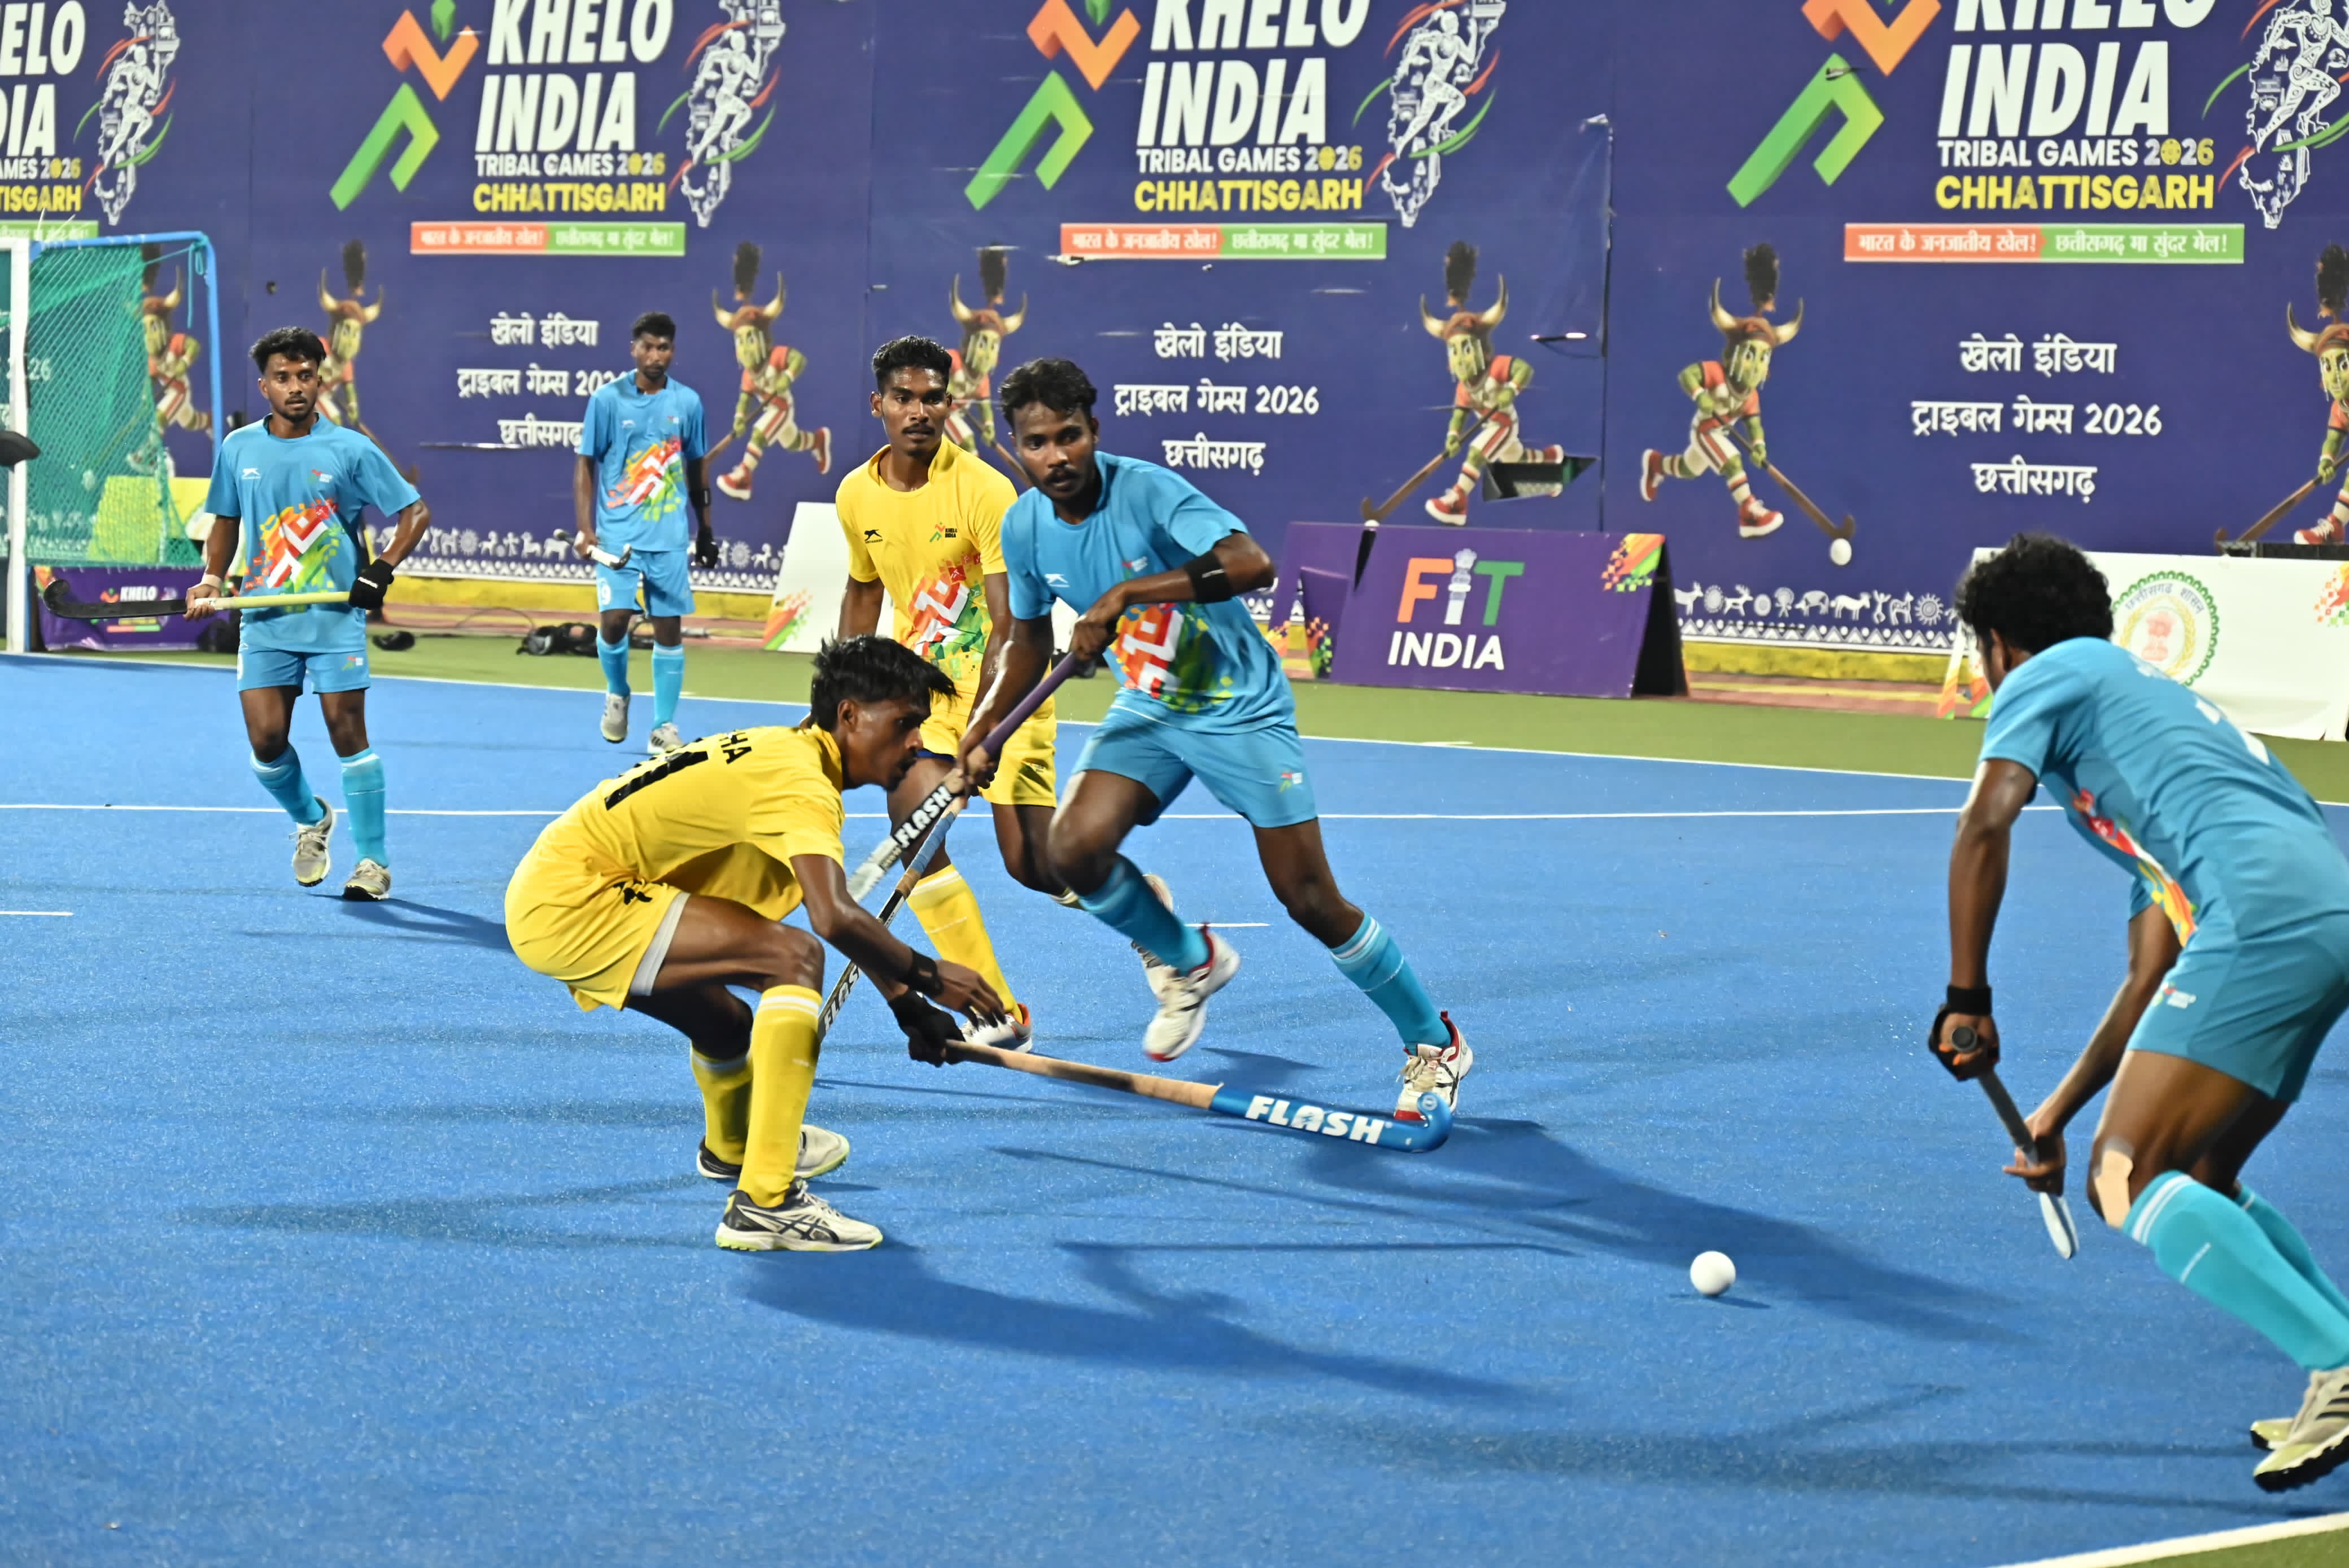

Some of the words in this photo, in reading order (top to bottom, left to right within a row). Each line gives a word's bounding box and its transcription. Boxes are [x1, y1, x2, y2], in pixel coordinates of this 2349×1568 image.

[0, 0, 85, 75] ELO
[487, 0, 673, 65] KHELO
[1137, 58, 1326, 148] INDIA
[1937, 41, 2169, 138] INDIA
[0, 84, 55, 156] IA
[475, 72, 636, 153] INDIA
[40, 158, 81, 178] 2026
[475, 154, 541, 177] TRIBAL
[543, 153, 614, 176] GAMES
[617, 152, 666, 176] 2026
[1136, 148, 1214, 173] TRIBAL
[1217, 147, 1300, 172] GAMES
[1304, 146, 1362, 171] 2026
[1937, 139, 2032, 167] TRIBAL
[2037, 138, 2138, 167] GAMES
[2144, 138, 2214, 165] 2026
[473, 182, 666, 212] CHHATTISGARH
[1134, 178, 1363, 211] CHHATTISGARH
[1936, 174, 2214, 209] CHHATTISGARH
[1900, 230, 1916, 251] के
[490, 311, 535, 345] खेलो
[539, 312, 599, 349] इंडिया
[1154, 322, 1207, 358] खेलो
[1213, 322, 1283, 362] इंडिया
[1959, 333, 2024, 372] खेलो
[2032, 333, 2117, 377] इंडिया
[457, 368, 521, 398] ट्राइबल
[526, 362, 570, 396] गेम्स
[1114, 384, 1190, 416] ट्राइबल
[1197, 378, 1247, 414] गेम्स
[1255, 385, 1320, 414] 2026
[1911, 401, 2003, 436] ट्राइबल
[2012, 394, 2074, 434] गेम्स
[2084, 403, 2162, 436] 2026
[1162, 432, 1267, 476] छत्तीसगढ़
[1970, 455, 2098, 504] छत्तीसगढ़
[1388, 631, 1505, 670] INDIA
[896, 784, 953, 848] FLASH
[823, 966, 863, 1036] FLAS
[1245, 1095, 1385, 1145] FLASH
